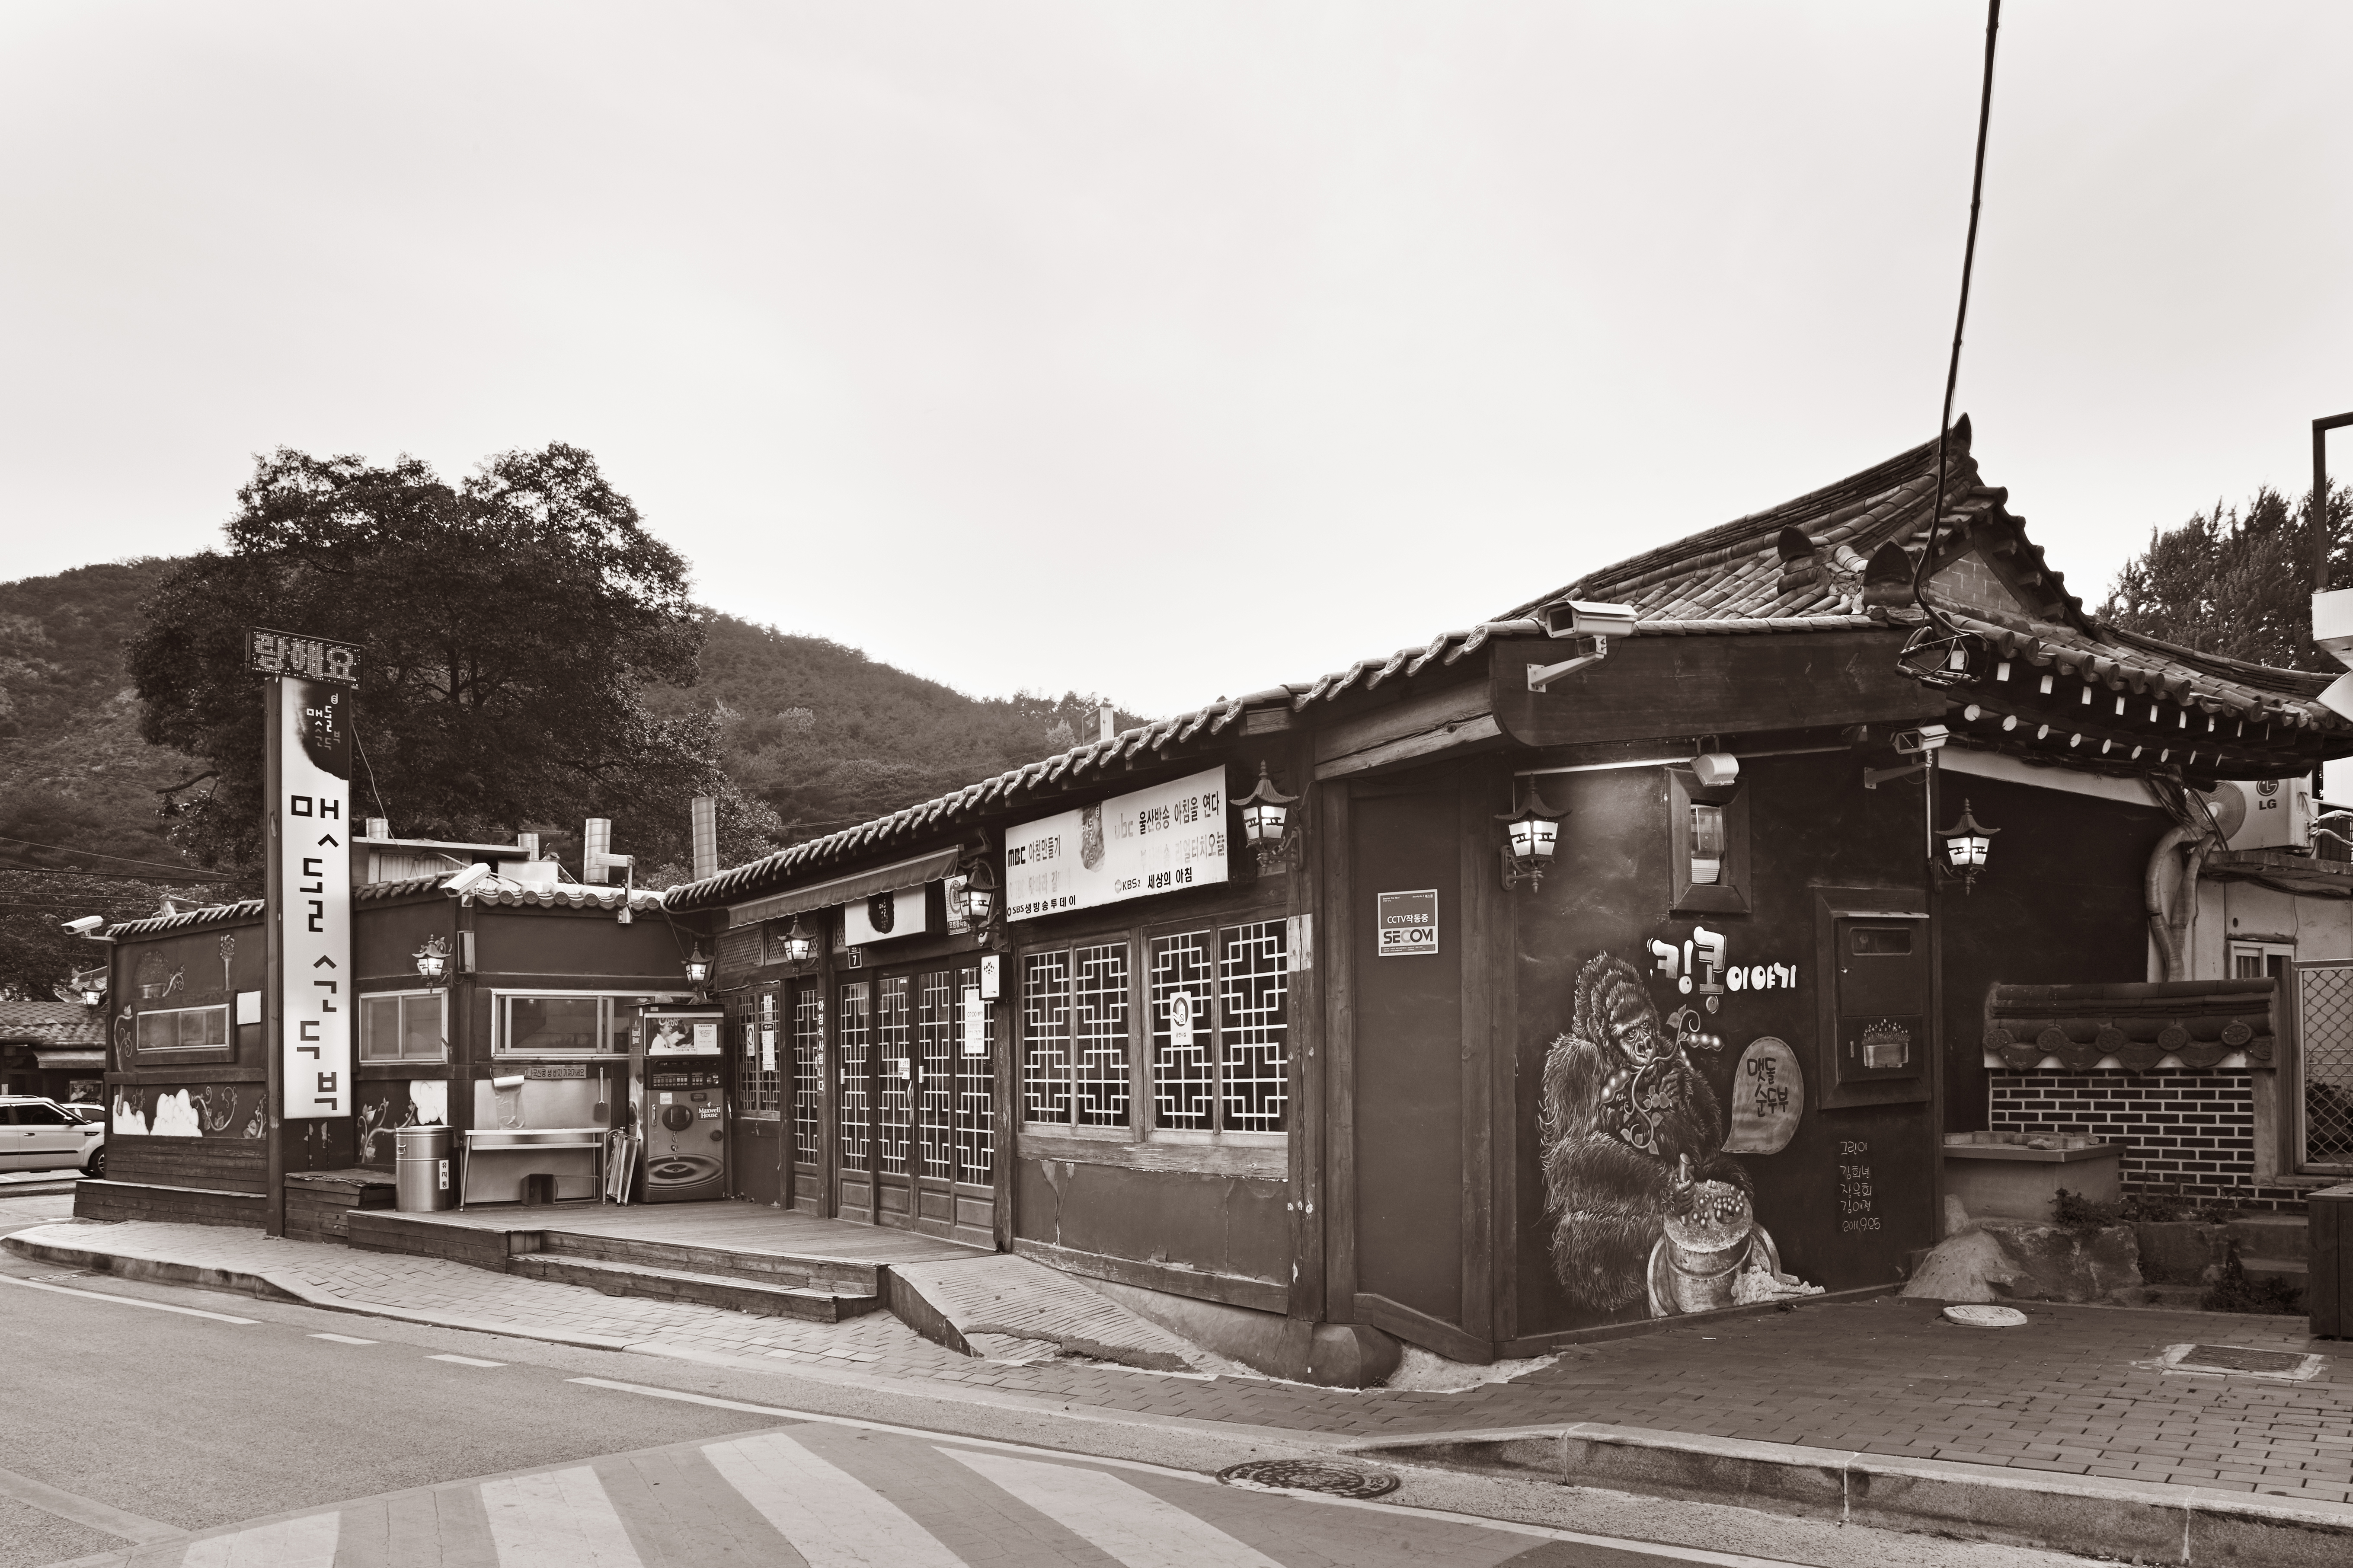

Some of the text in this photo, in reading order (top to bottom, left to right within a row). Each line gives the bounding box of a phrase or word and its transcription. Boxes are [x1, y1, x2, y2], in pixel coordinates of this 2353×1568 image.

[2259, 799, 2277, 810] LG
[1139, 805, 1170, 835] 울산방송
[1174, 797, 1198, 825] 아침을
[1203, 791, 1219, 818] 연다
[1008, 834, 1060, 867] MBC 아침만들기
[1148, 871, 1171, 889] 세상의
[1176, 867, 1192, 883] 아침
[1013, 905, 1024, 914] SBS
[1384, 929, 1433, 944] SECOM
[852, 955, 857, 965] 7
[1651, 926, 1797, 1014] 킹콩 이야기
[533, 1069, 546, 1077] 국산콩
[553, 1069, 562, 1077] 비지
[563, 1068, 584, 1077] 가져가세요
[1747, 1057, 1777, 1085] 맷돌
[1755, 1083, 1789, 1118] 순두부
[1840, 1141, 1867, 1155] 그린이
[1840, 1182, 1872, 1198] 장은희
[1841, 1200, 1871, 1214] 김애정
